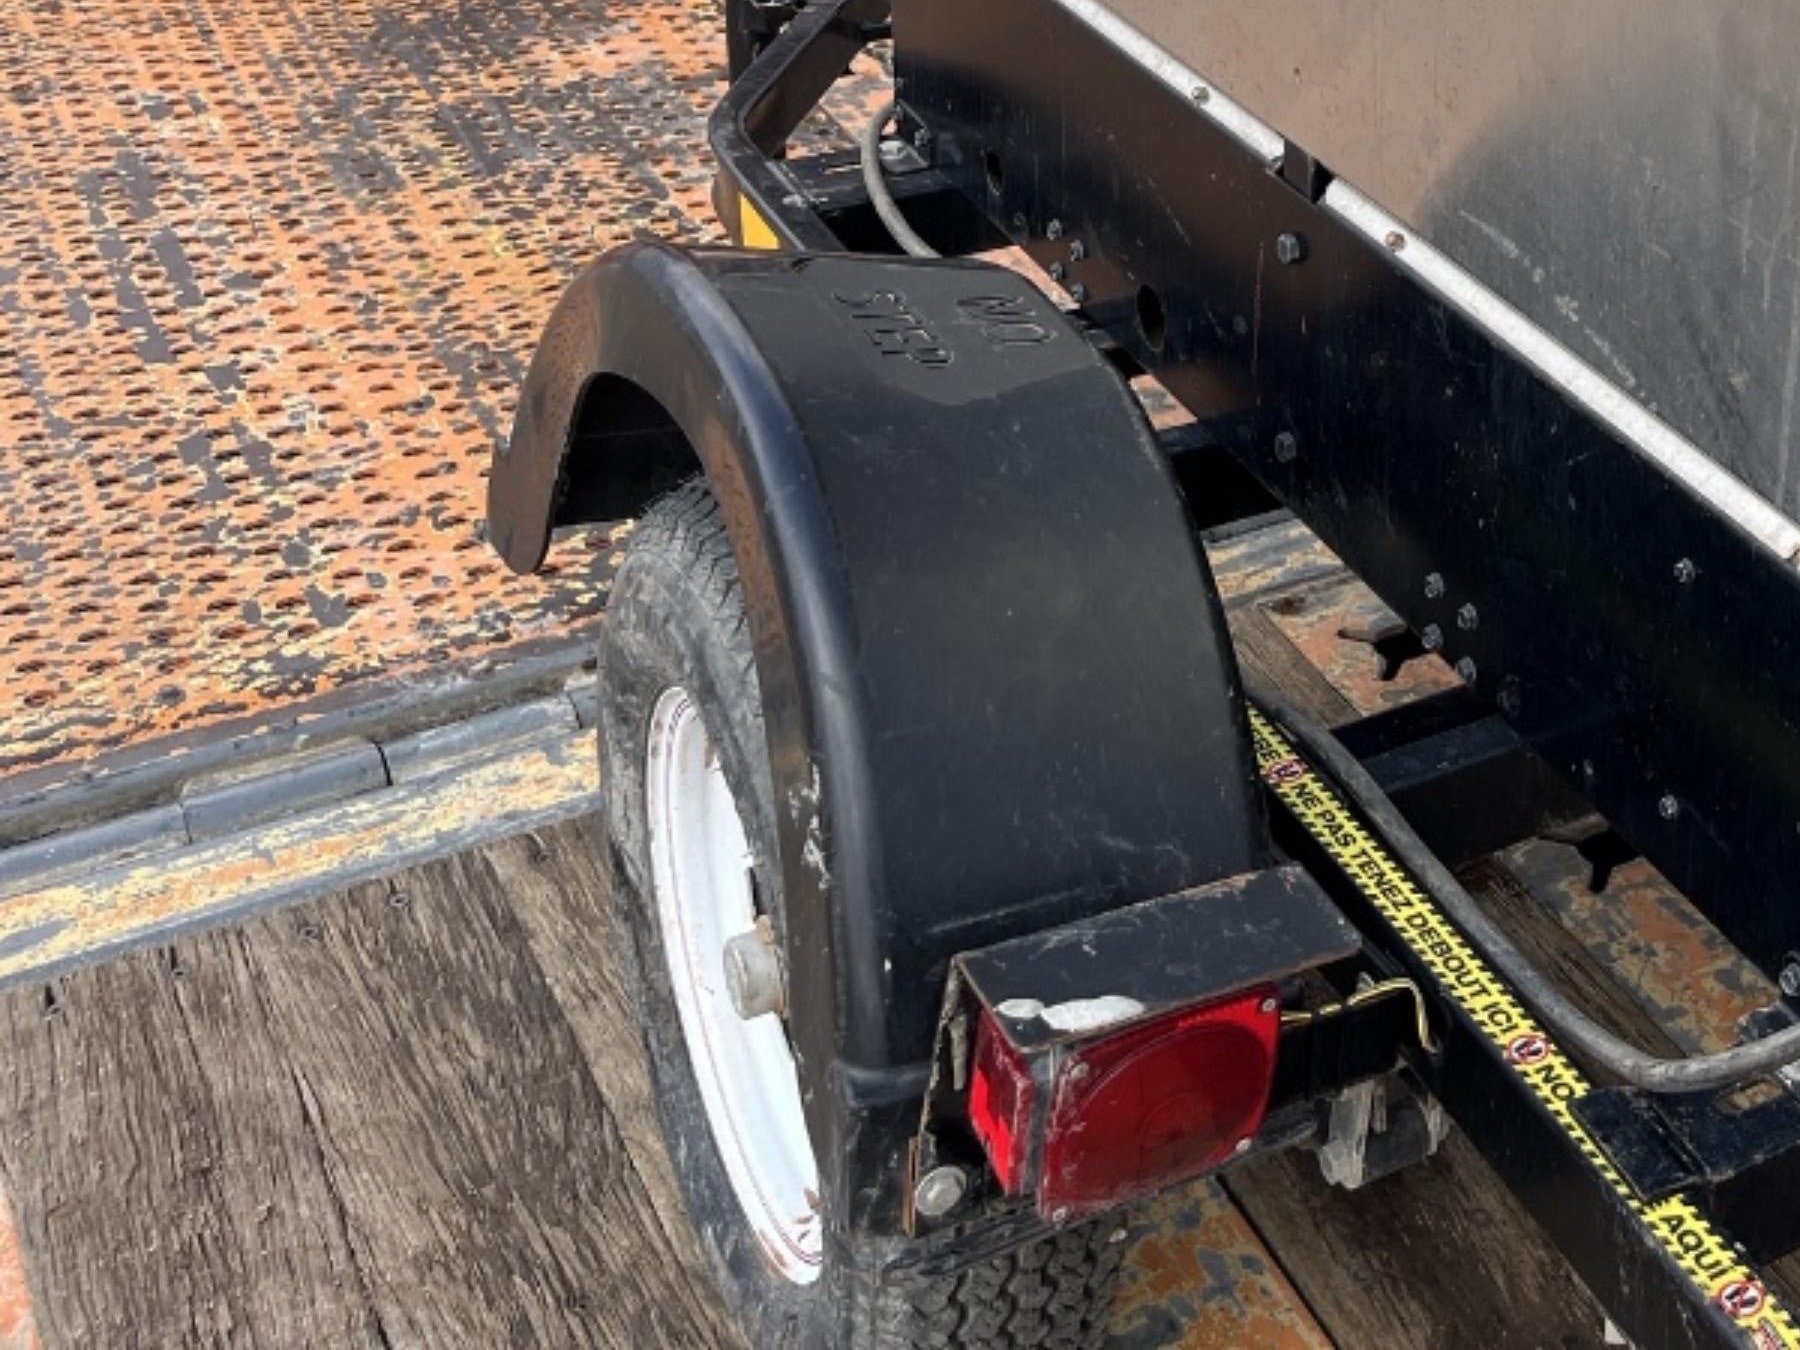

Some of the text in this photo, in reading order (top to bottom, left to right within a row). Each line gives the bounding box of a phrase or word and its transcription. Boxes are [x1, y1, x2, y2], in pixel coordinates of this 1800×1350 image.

[1291, 781, 1519, 1034] NE PAS TENEZ DEBOUT ICI
[1534, 1063, 1576, 1101] NO
